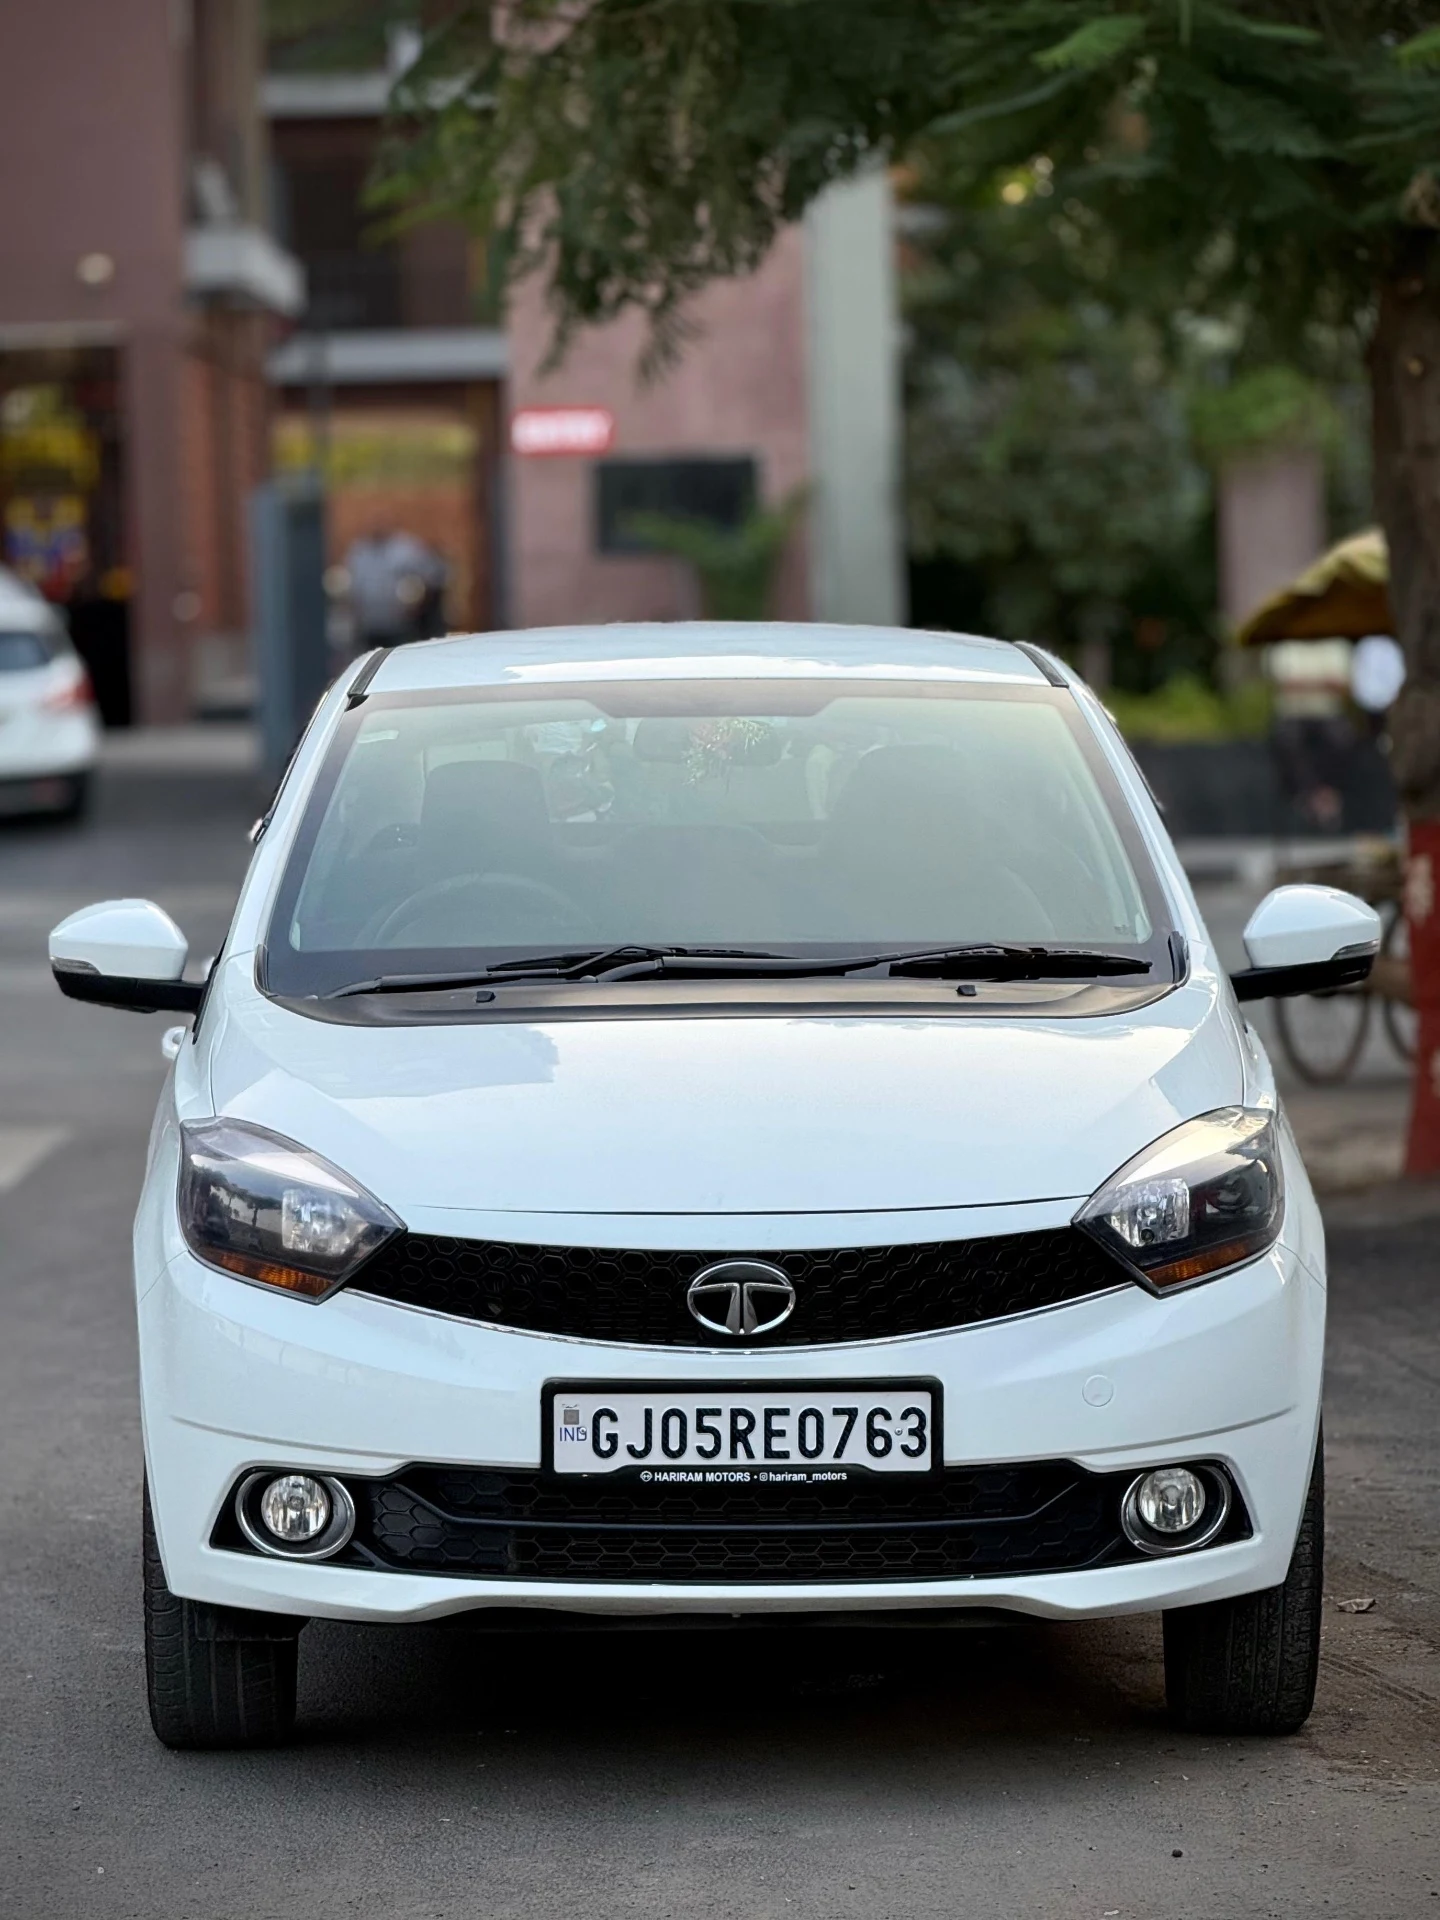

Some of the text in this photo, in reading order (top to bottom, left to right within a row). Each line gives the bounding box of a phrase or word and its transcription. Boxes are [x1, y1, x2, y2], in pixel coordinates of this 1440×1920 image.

[559, 1427, 587, 1442] IND
[591, 1407, 927, 1459] GJ05RE0763
[654, 1471, 847, 1483] HARIRAM MOTORS hariram_motors
